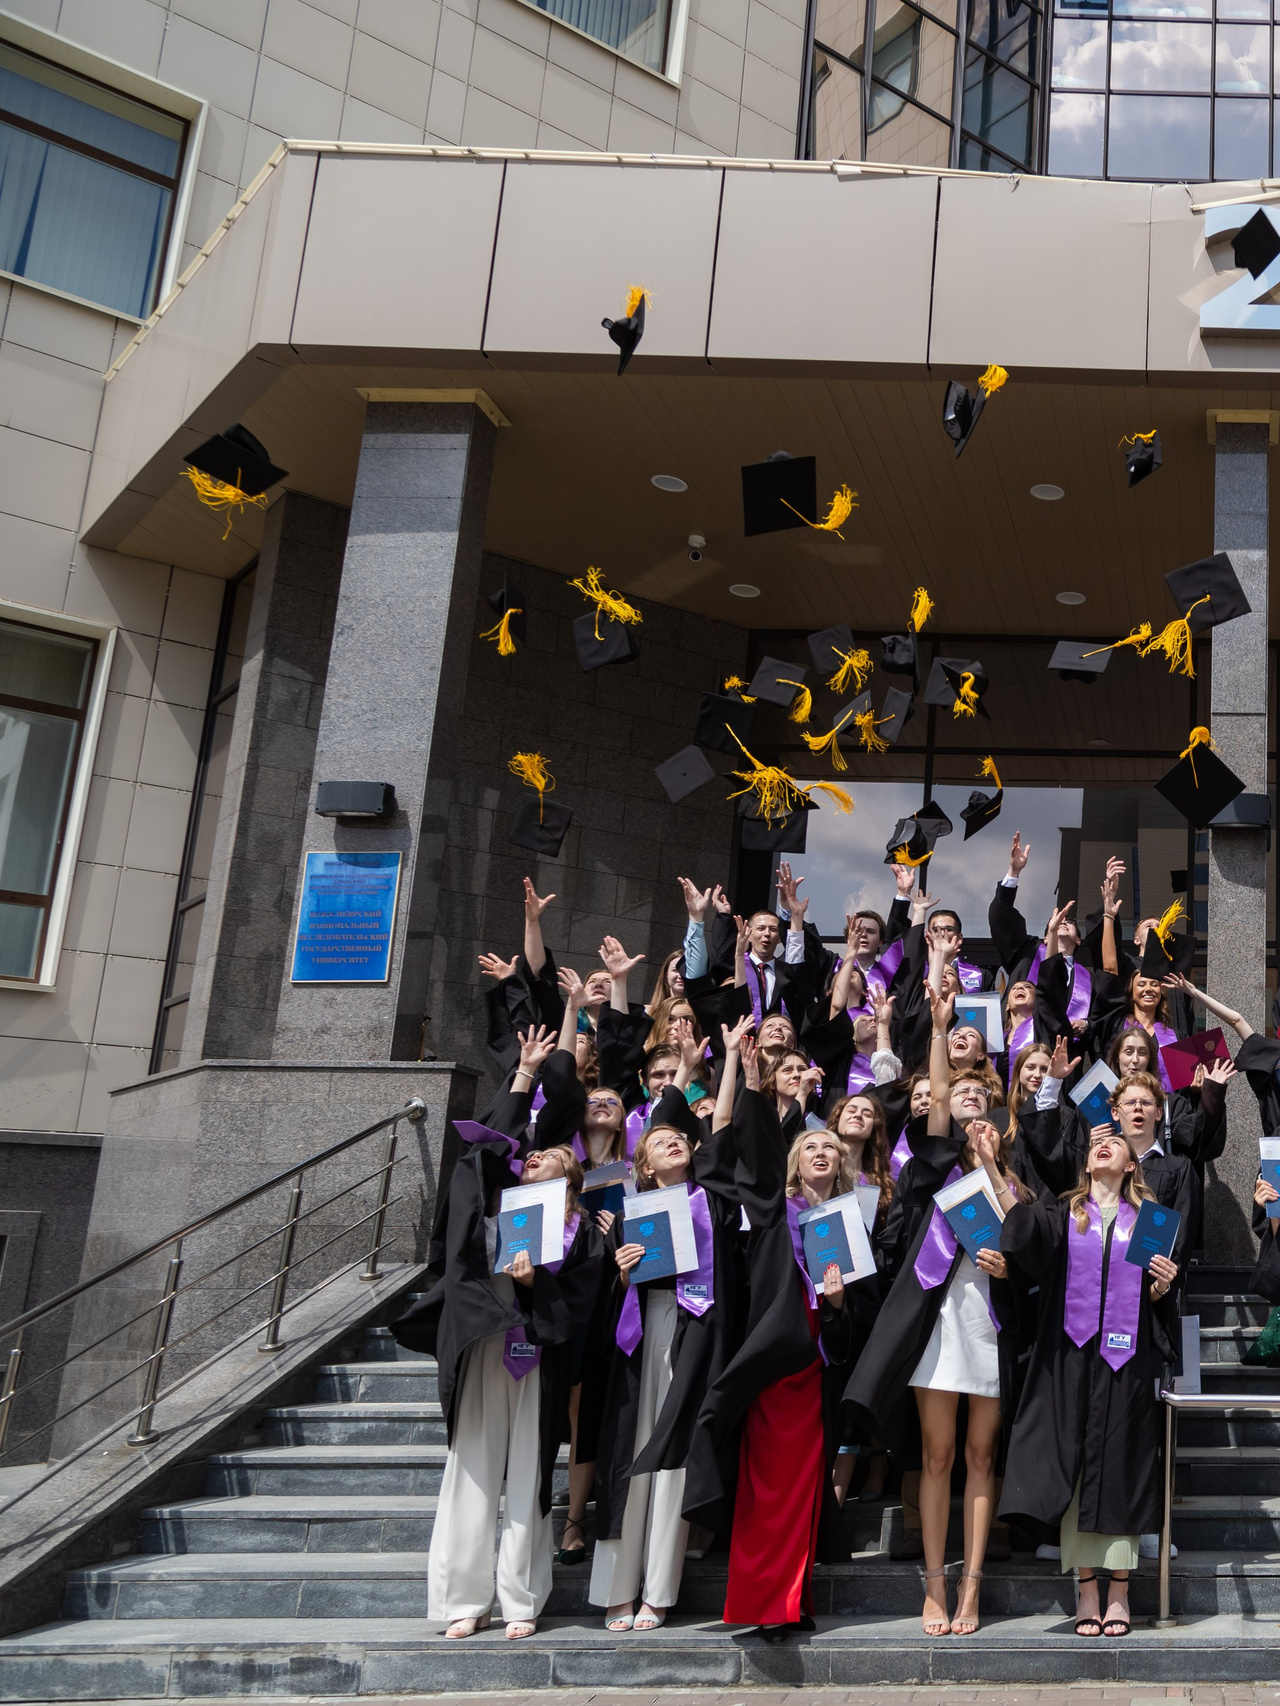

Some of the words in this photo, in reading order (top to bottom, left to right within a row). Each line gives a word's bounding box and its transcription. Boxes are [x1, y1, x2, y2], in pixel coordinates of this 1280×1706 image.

[309, 921, 380, 929] НАЦИОНАЛЬНЫЙ
[299, 933, 388, 941] ИССЛЕДОВАТЕЛЬСКИЙ
[301, 944, 382, 952] ГОСУДАРСТВЕННЫЙ
